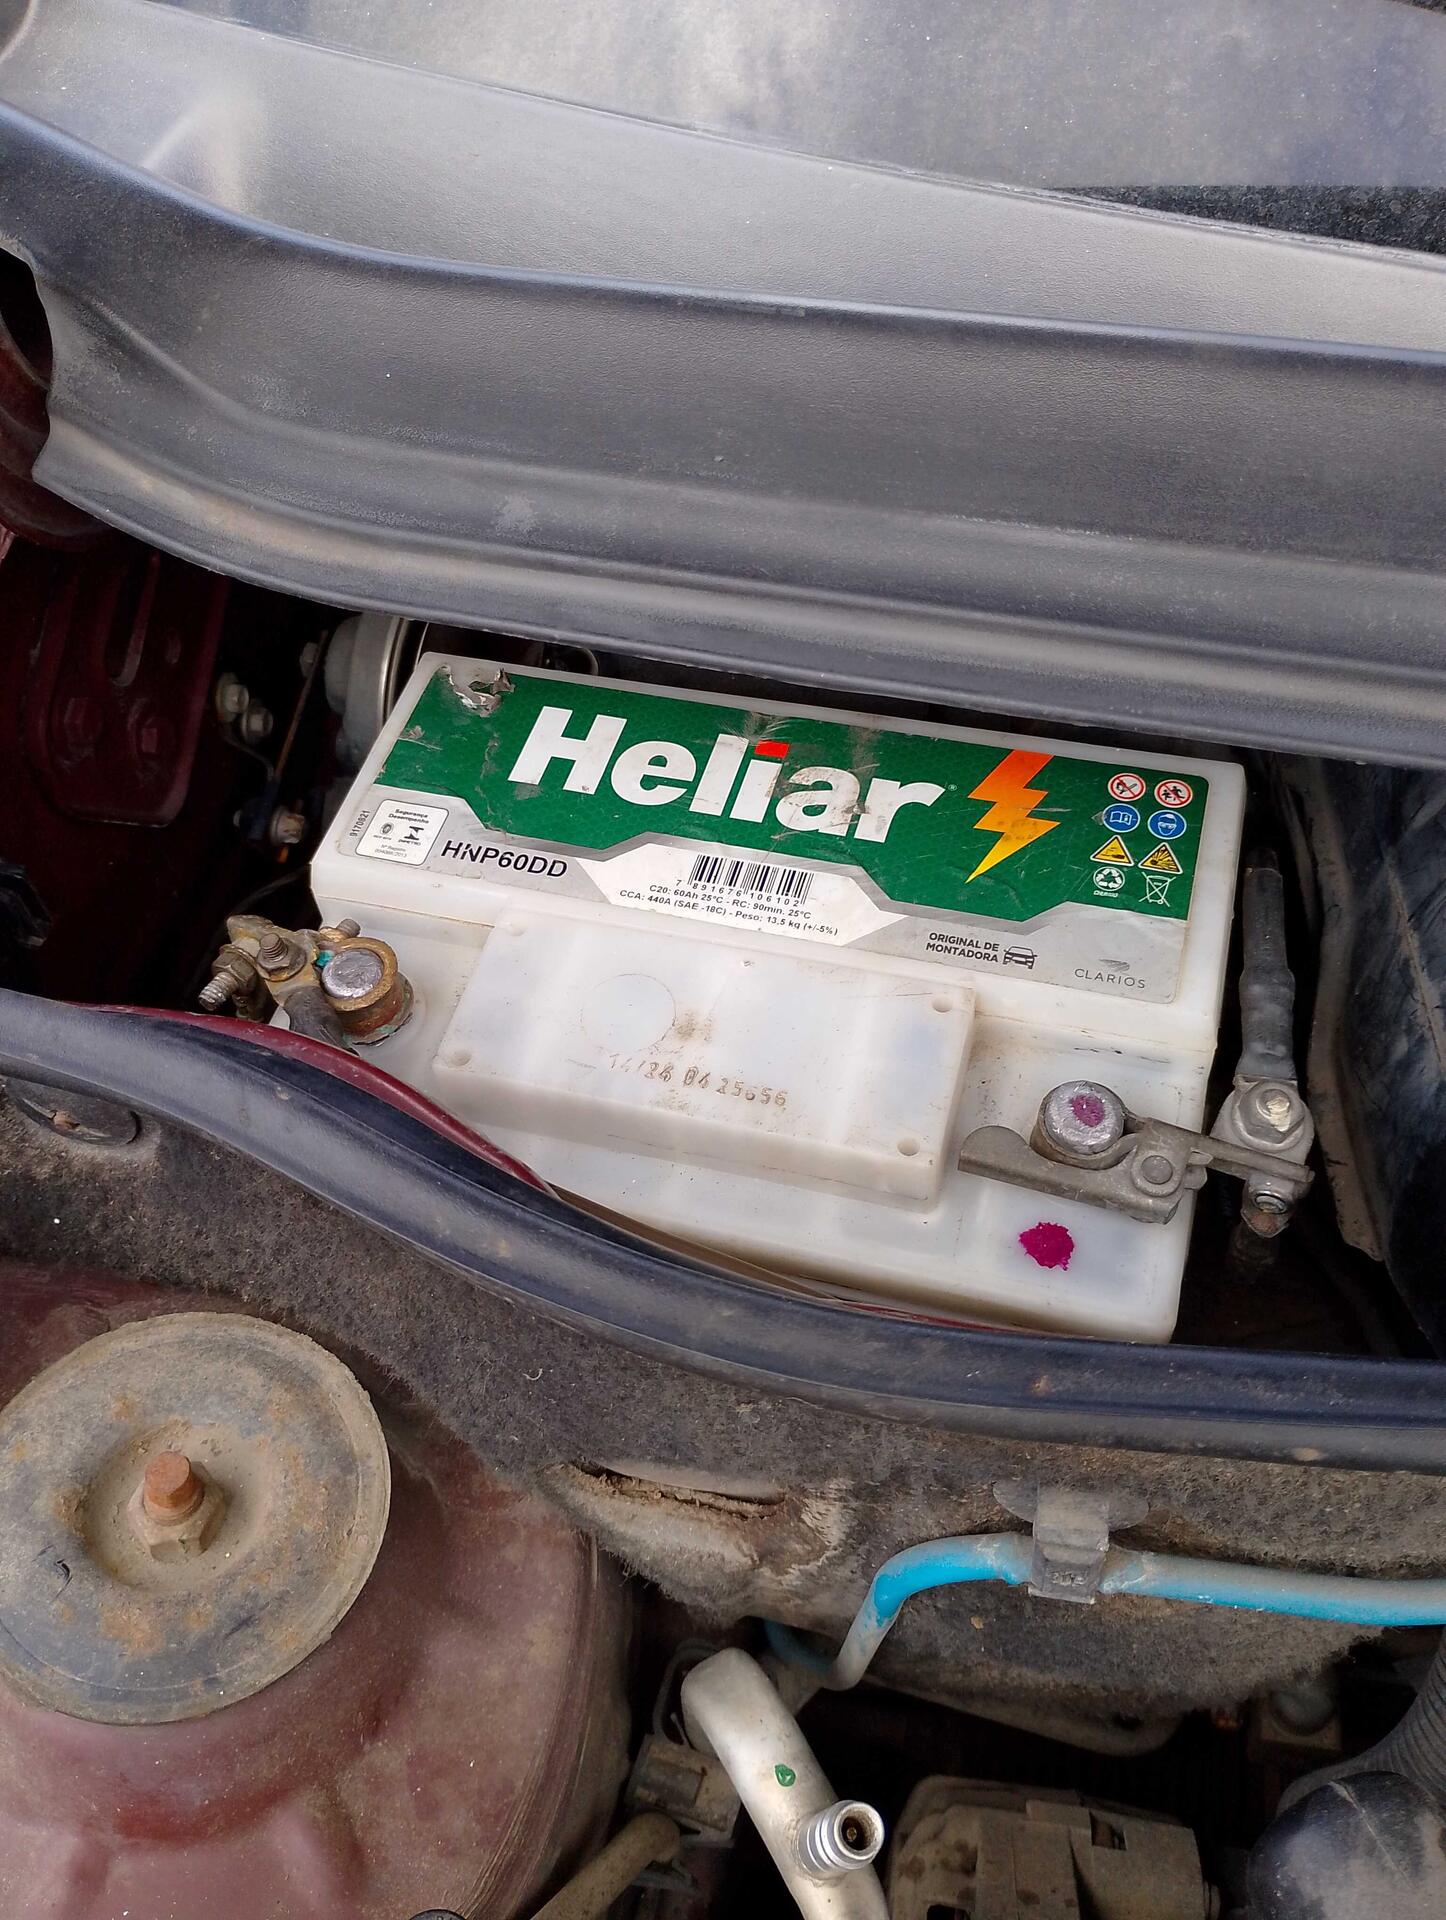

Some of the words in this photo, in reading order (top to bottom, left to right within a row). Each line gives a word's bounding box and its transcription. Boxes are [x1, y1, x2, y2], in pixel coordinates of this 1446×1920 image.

[507, 705, 946, 843] Heliar
[388, 813, 429, 824] Desempenho
[395, 808, 429, 819] Segurança
[441, 840, 568, 877] HNP60DD
[619, 889, 646, 901] CCA:
[647, 895, 671, 905] 440A
[674, 899, 699, 910] (SAE
[701, 905, 727, 916] -18C)
[735, 910, 763, 922] Peso:
[788, 920, 801, 930] kg
[649, 884, 672, 895] C20:
[673, 888, 699, 899] 60Ah
[700, 893, 724, 904] 25°C
[732, 899, 751, 909] RC:
[753, 903, 785, 915] 90min.
[788, 909, 812, 920] 25°C
[926, 942, 999, 963] MONTADORA
[929, 932, 982, 949] ORIGINAL
[984, 942, 1000, 952] DE
[1074, 968, 1146, 989] CLARIOS
